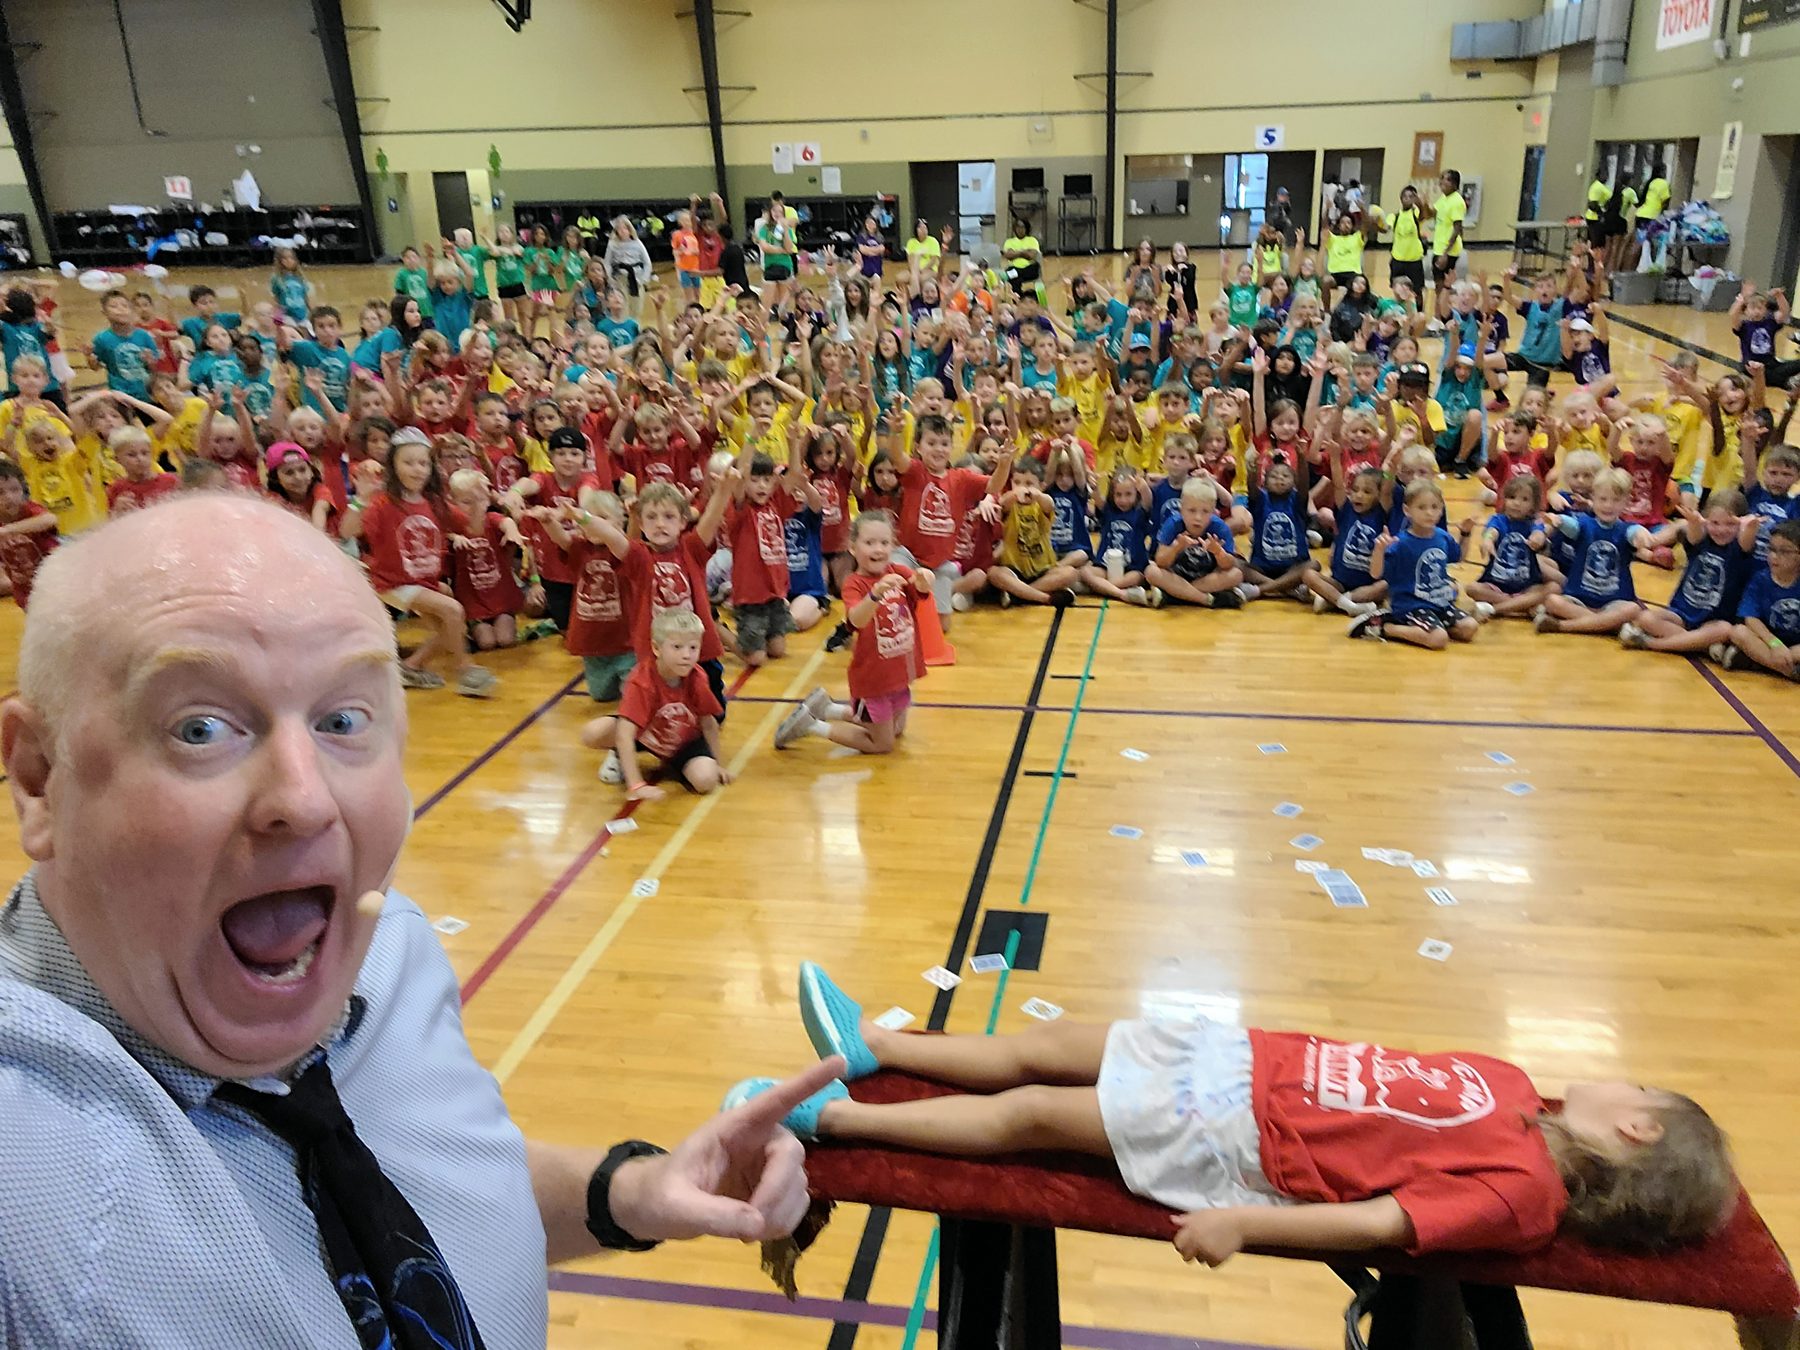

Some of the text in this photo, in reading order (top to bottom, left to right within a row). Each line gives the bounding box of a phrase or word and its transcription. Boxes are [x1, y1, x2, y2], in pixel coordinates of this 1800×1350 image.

[1662, 0, 1709, 37] TOYOTA
[1263, 127, 1276, 146] 5
[802, 145, 814, 161] 6
